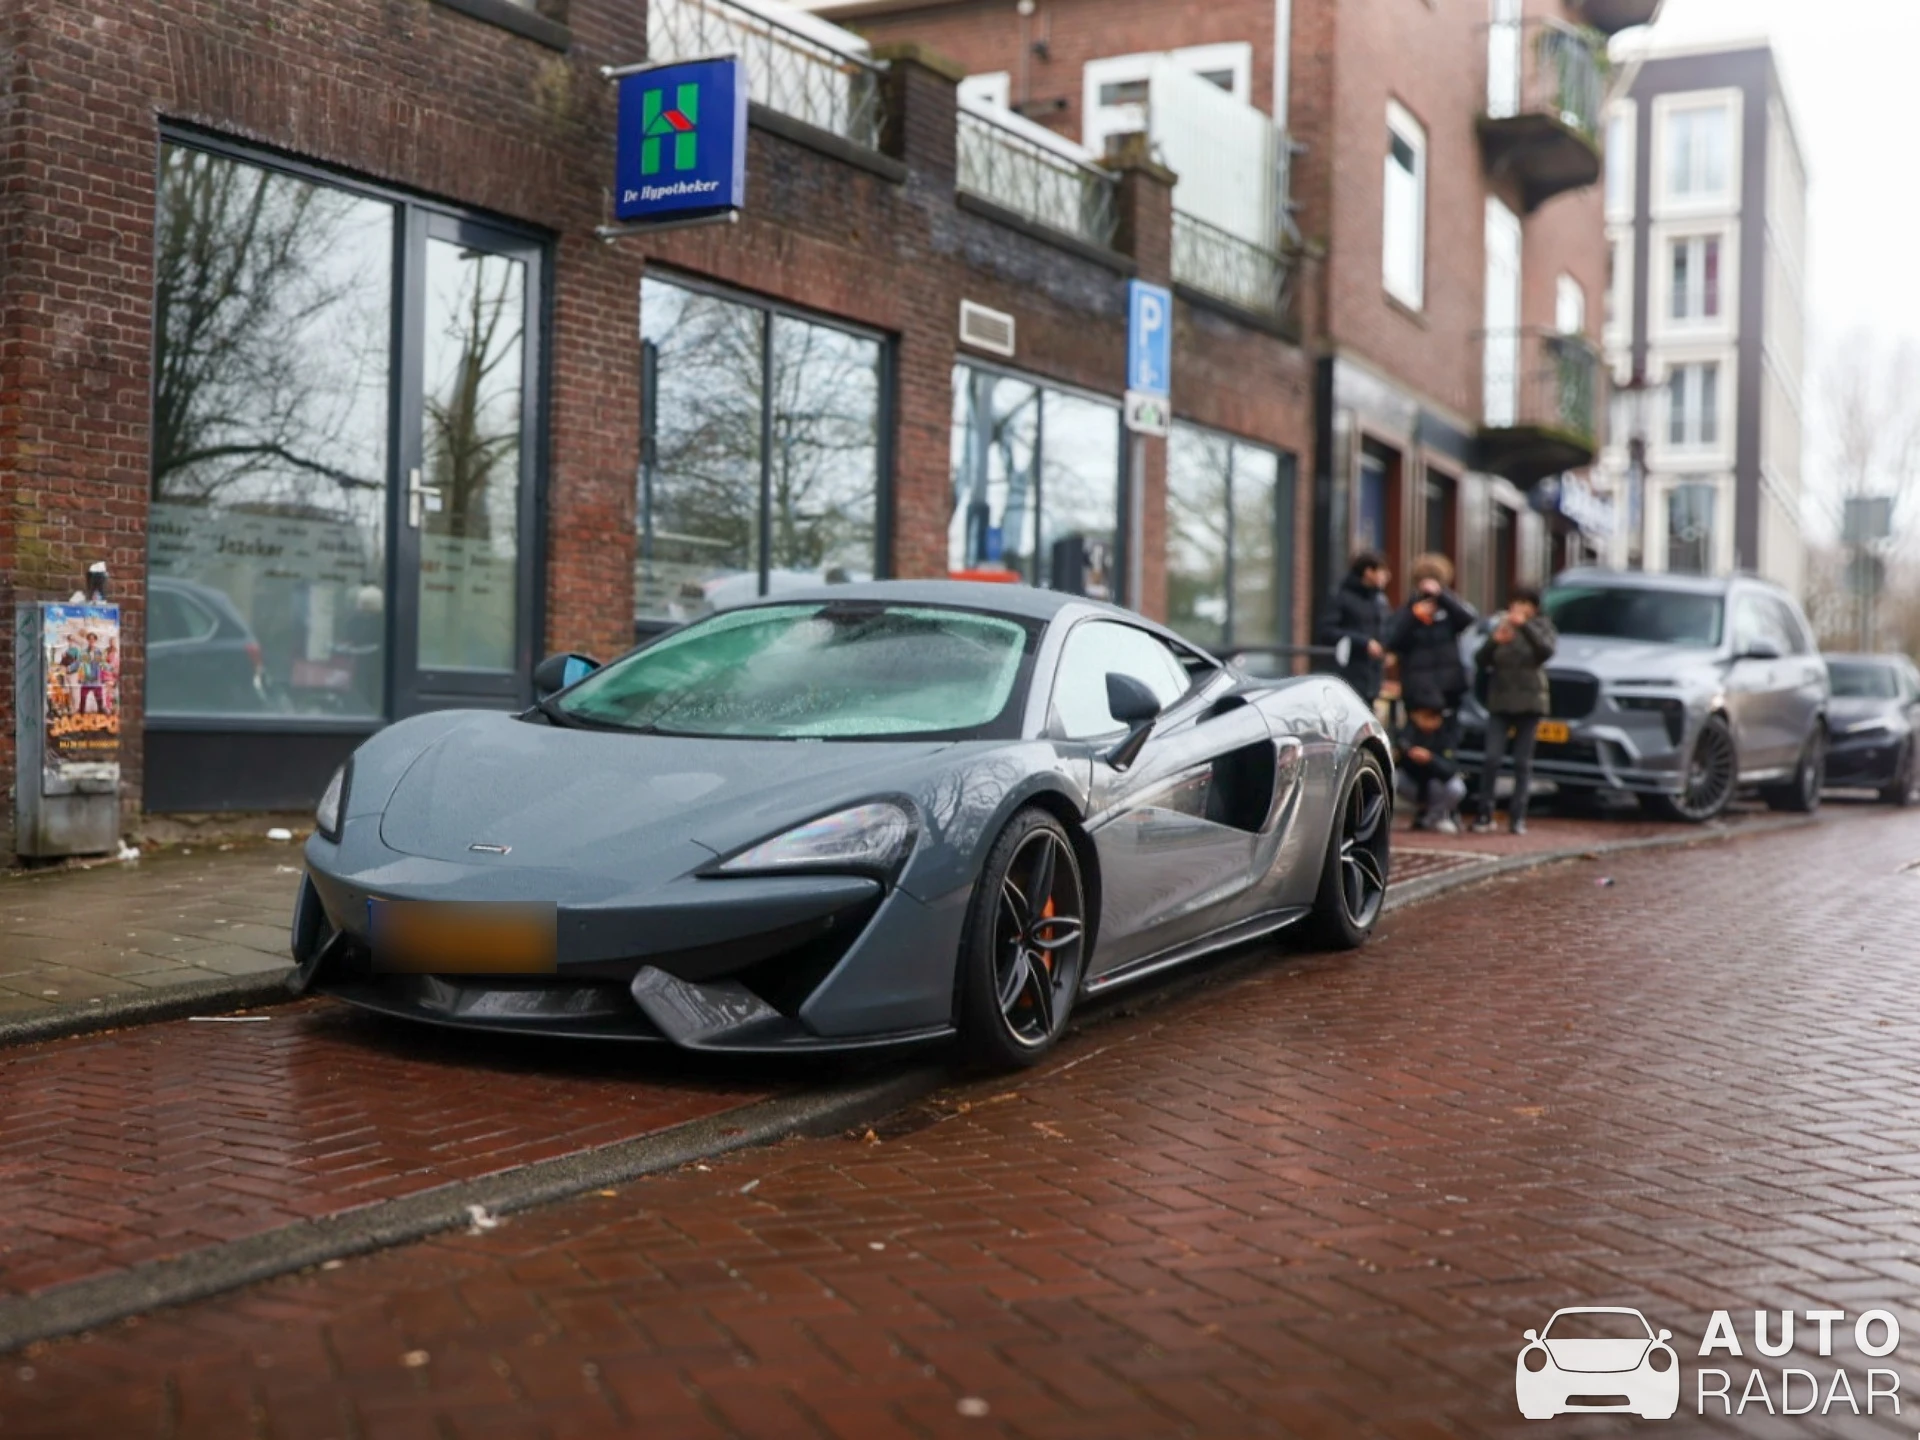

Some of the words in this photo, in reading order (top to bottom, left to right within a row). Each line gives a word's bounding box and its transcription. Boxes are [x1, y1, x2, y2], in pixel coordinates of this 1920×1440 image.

[623, 189, 638, 203] De
[641, 179, 719, 201] Hypotheker
[1139, 295, 1163, 348] P
